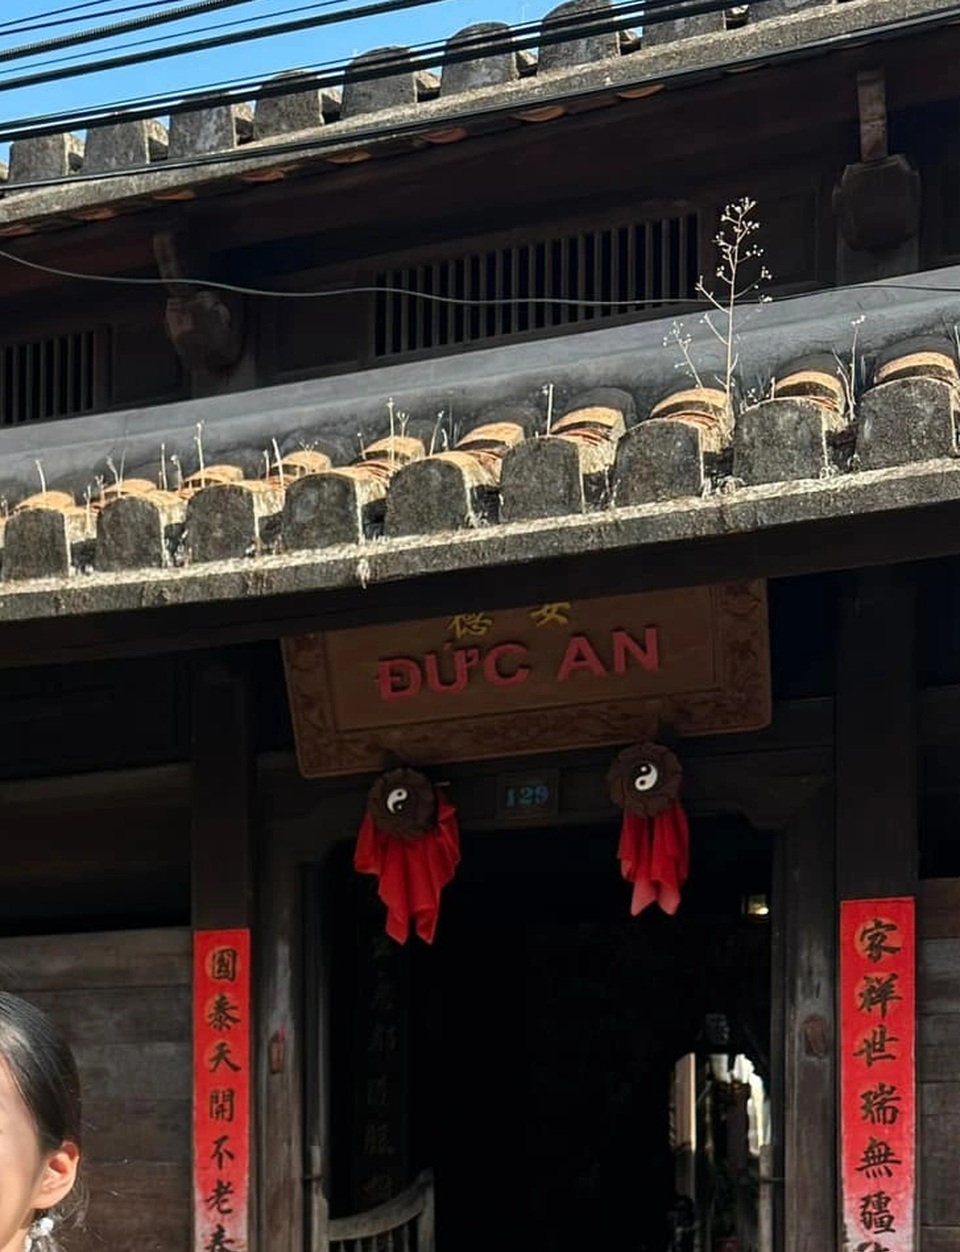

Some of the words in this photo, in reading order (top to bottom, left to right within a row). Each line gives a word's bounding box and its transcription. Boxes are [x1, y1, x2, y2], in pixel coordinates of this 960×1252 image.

[376, 641, 529, 700] ĐỨC
[557, 627, 660, 681] AN
[506, 785, 550, 808] 129
